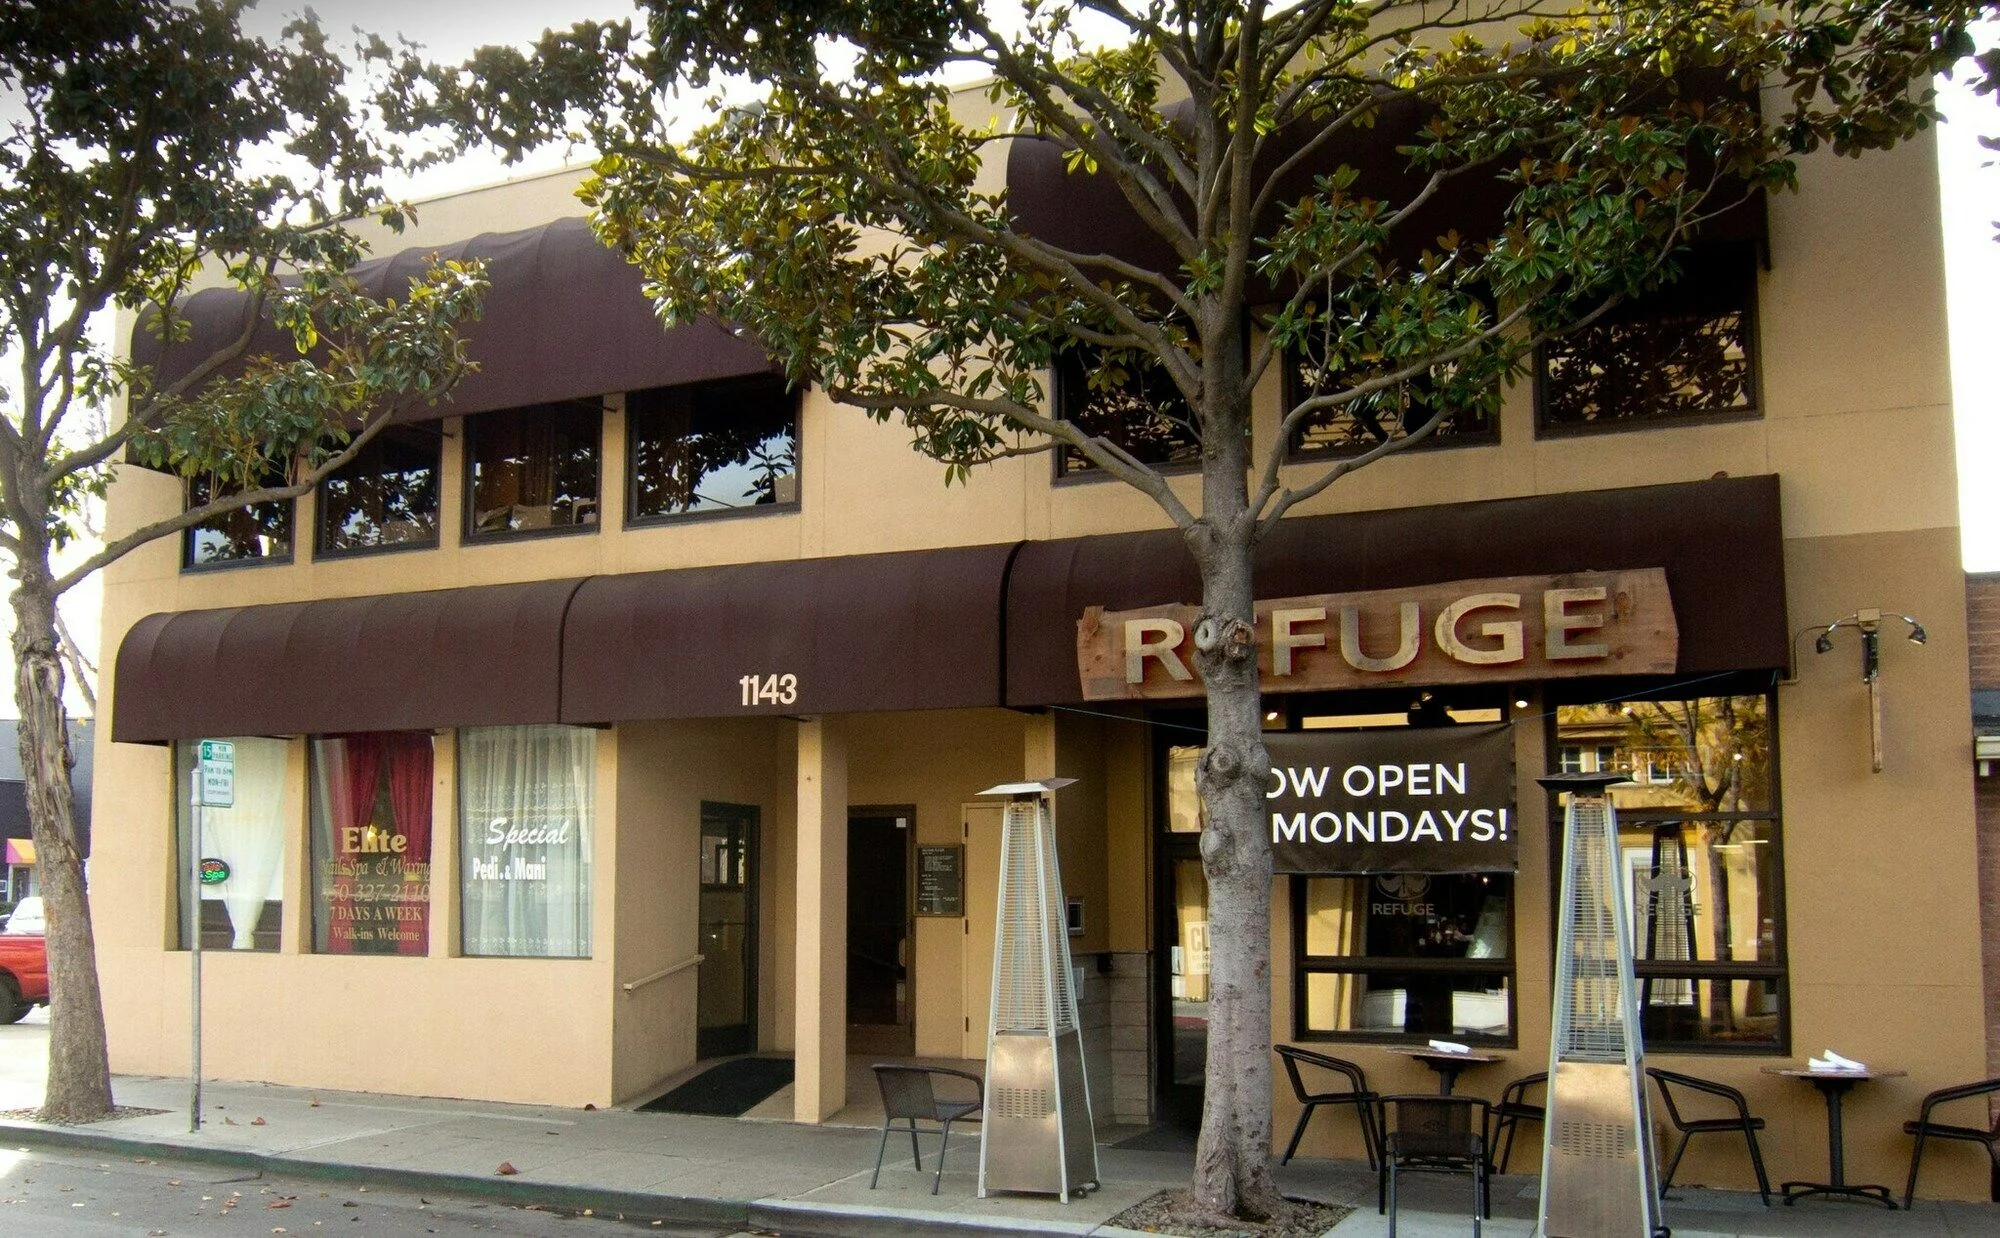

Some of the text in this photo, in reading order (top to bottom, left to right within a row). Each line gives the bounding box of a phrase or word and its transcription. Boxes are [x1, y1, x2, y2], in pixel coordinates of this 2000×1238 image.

[1125, 587, 1609, 684] RFUGE
[739, 673, 797, 706] 1143
[1265, 762, 1466, 799] OW OPEN
[341, 826, 408, 853] Elite
[486, 818, 569, 851] Special
[1272, 808, 1508, 844] MONDAYS!
[205, 870, 226, 880] Spa
[515, 856, 546, 880] Mani
[338, 907, 371, 920] DAYS
[374, 906, 383, 920] A
[385, 907, 422, 920] WEEK
[1372, 903, 1436, 916] REFUGE
[333, 927, 420, 940] Walk-ins Welcome
